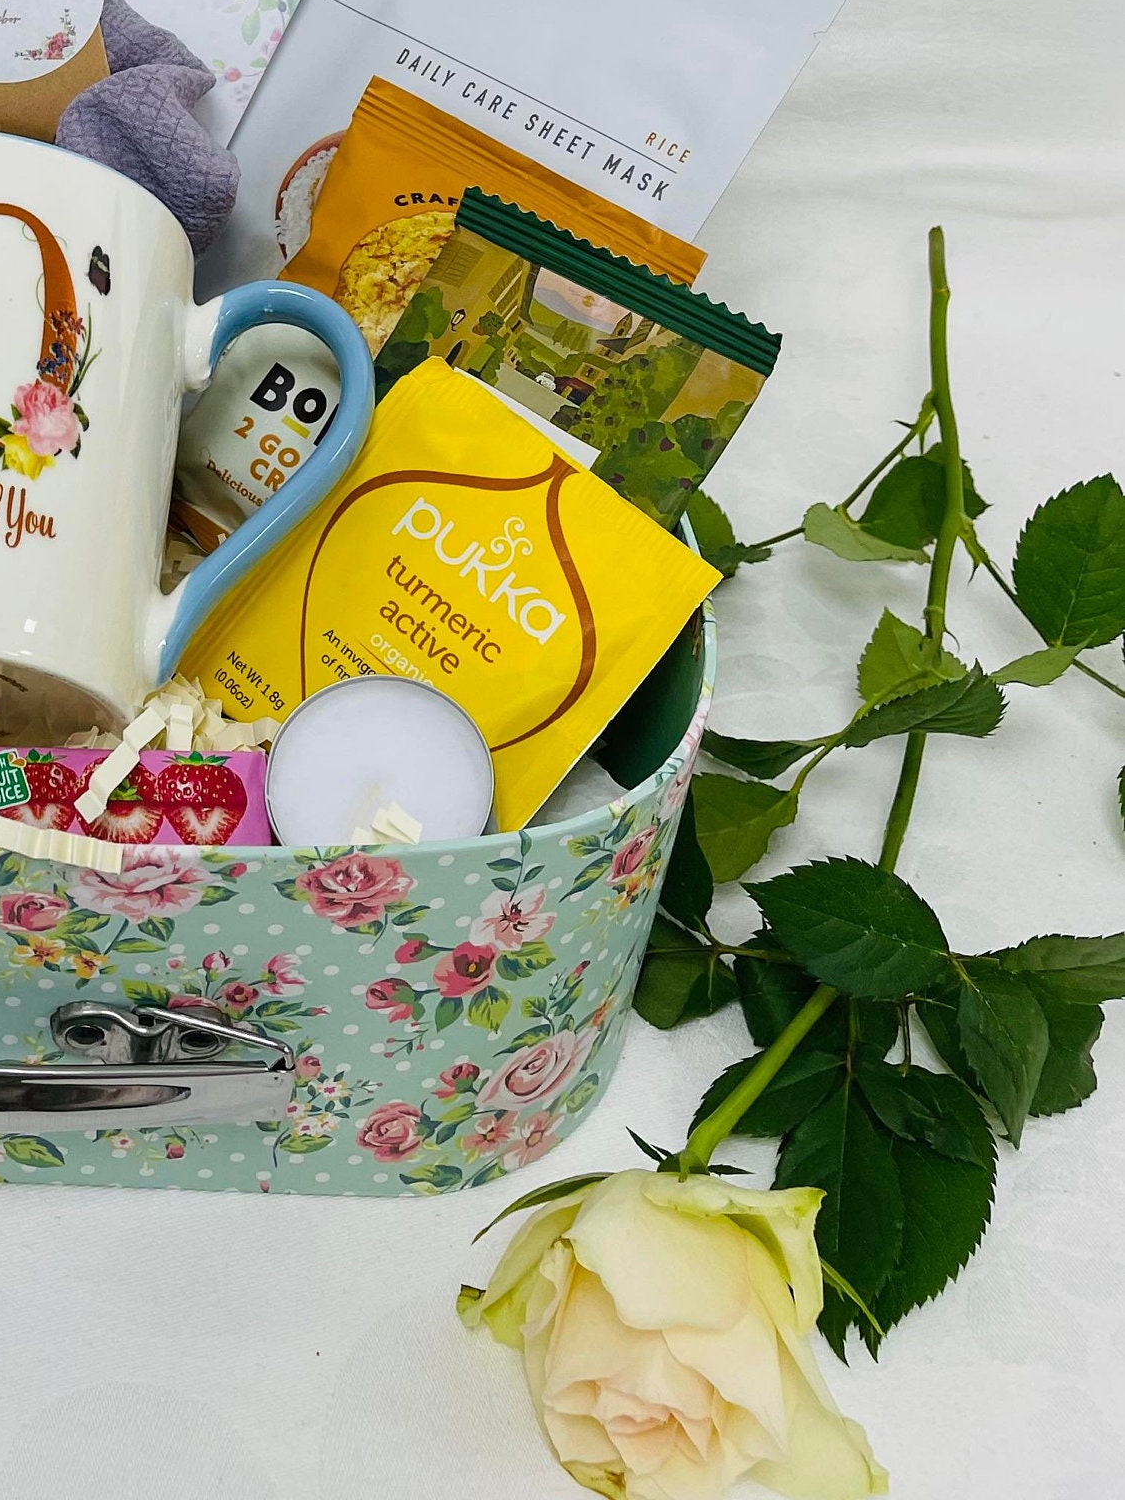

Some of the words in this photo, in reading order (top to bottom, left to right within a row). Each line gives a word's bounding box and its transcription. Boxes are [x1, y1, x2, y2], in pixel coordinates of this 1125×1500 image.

[395, 47, 456, 89] DAILY
[461, 81, 518, 121] CARE
[524, 113, 595, 162] SHEET
[602, 153, 671, 202] MASK
[645, 131, 692, 165] RICE
[233, 416, 255, 440] 2
[206, 459, 263, 507] Delicious
[5, 484, 57, 549] You
[385, 554, 502, 664] turmeric
[322, 629, 341, 648] An
[379, 598, 461, 676] active
[227, 650, 247, 674] Net
[247, 667, 263, 689] Wt
[321, 654, 338, 668] of
[214, 667, 255, 710] (0.06oz)
